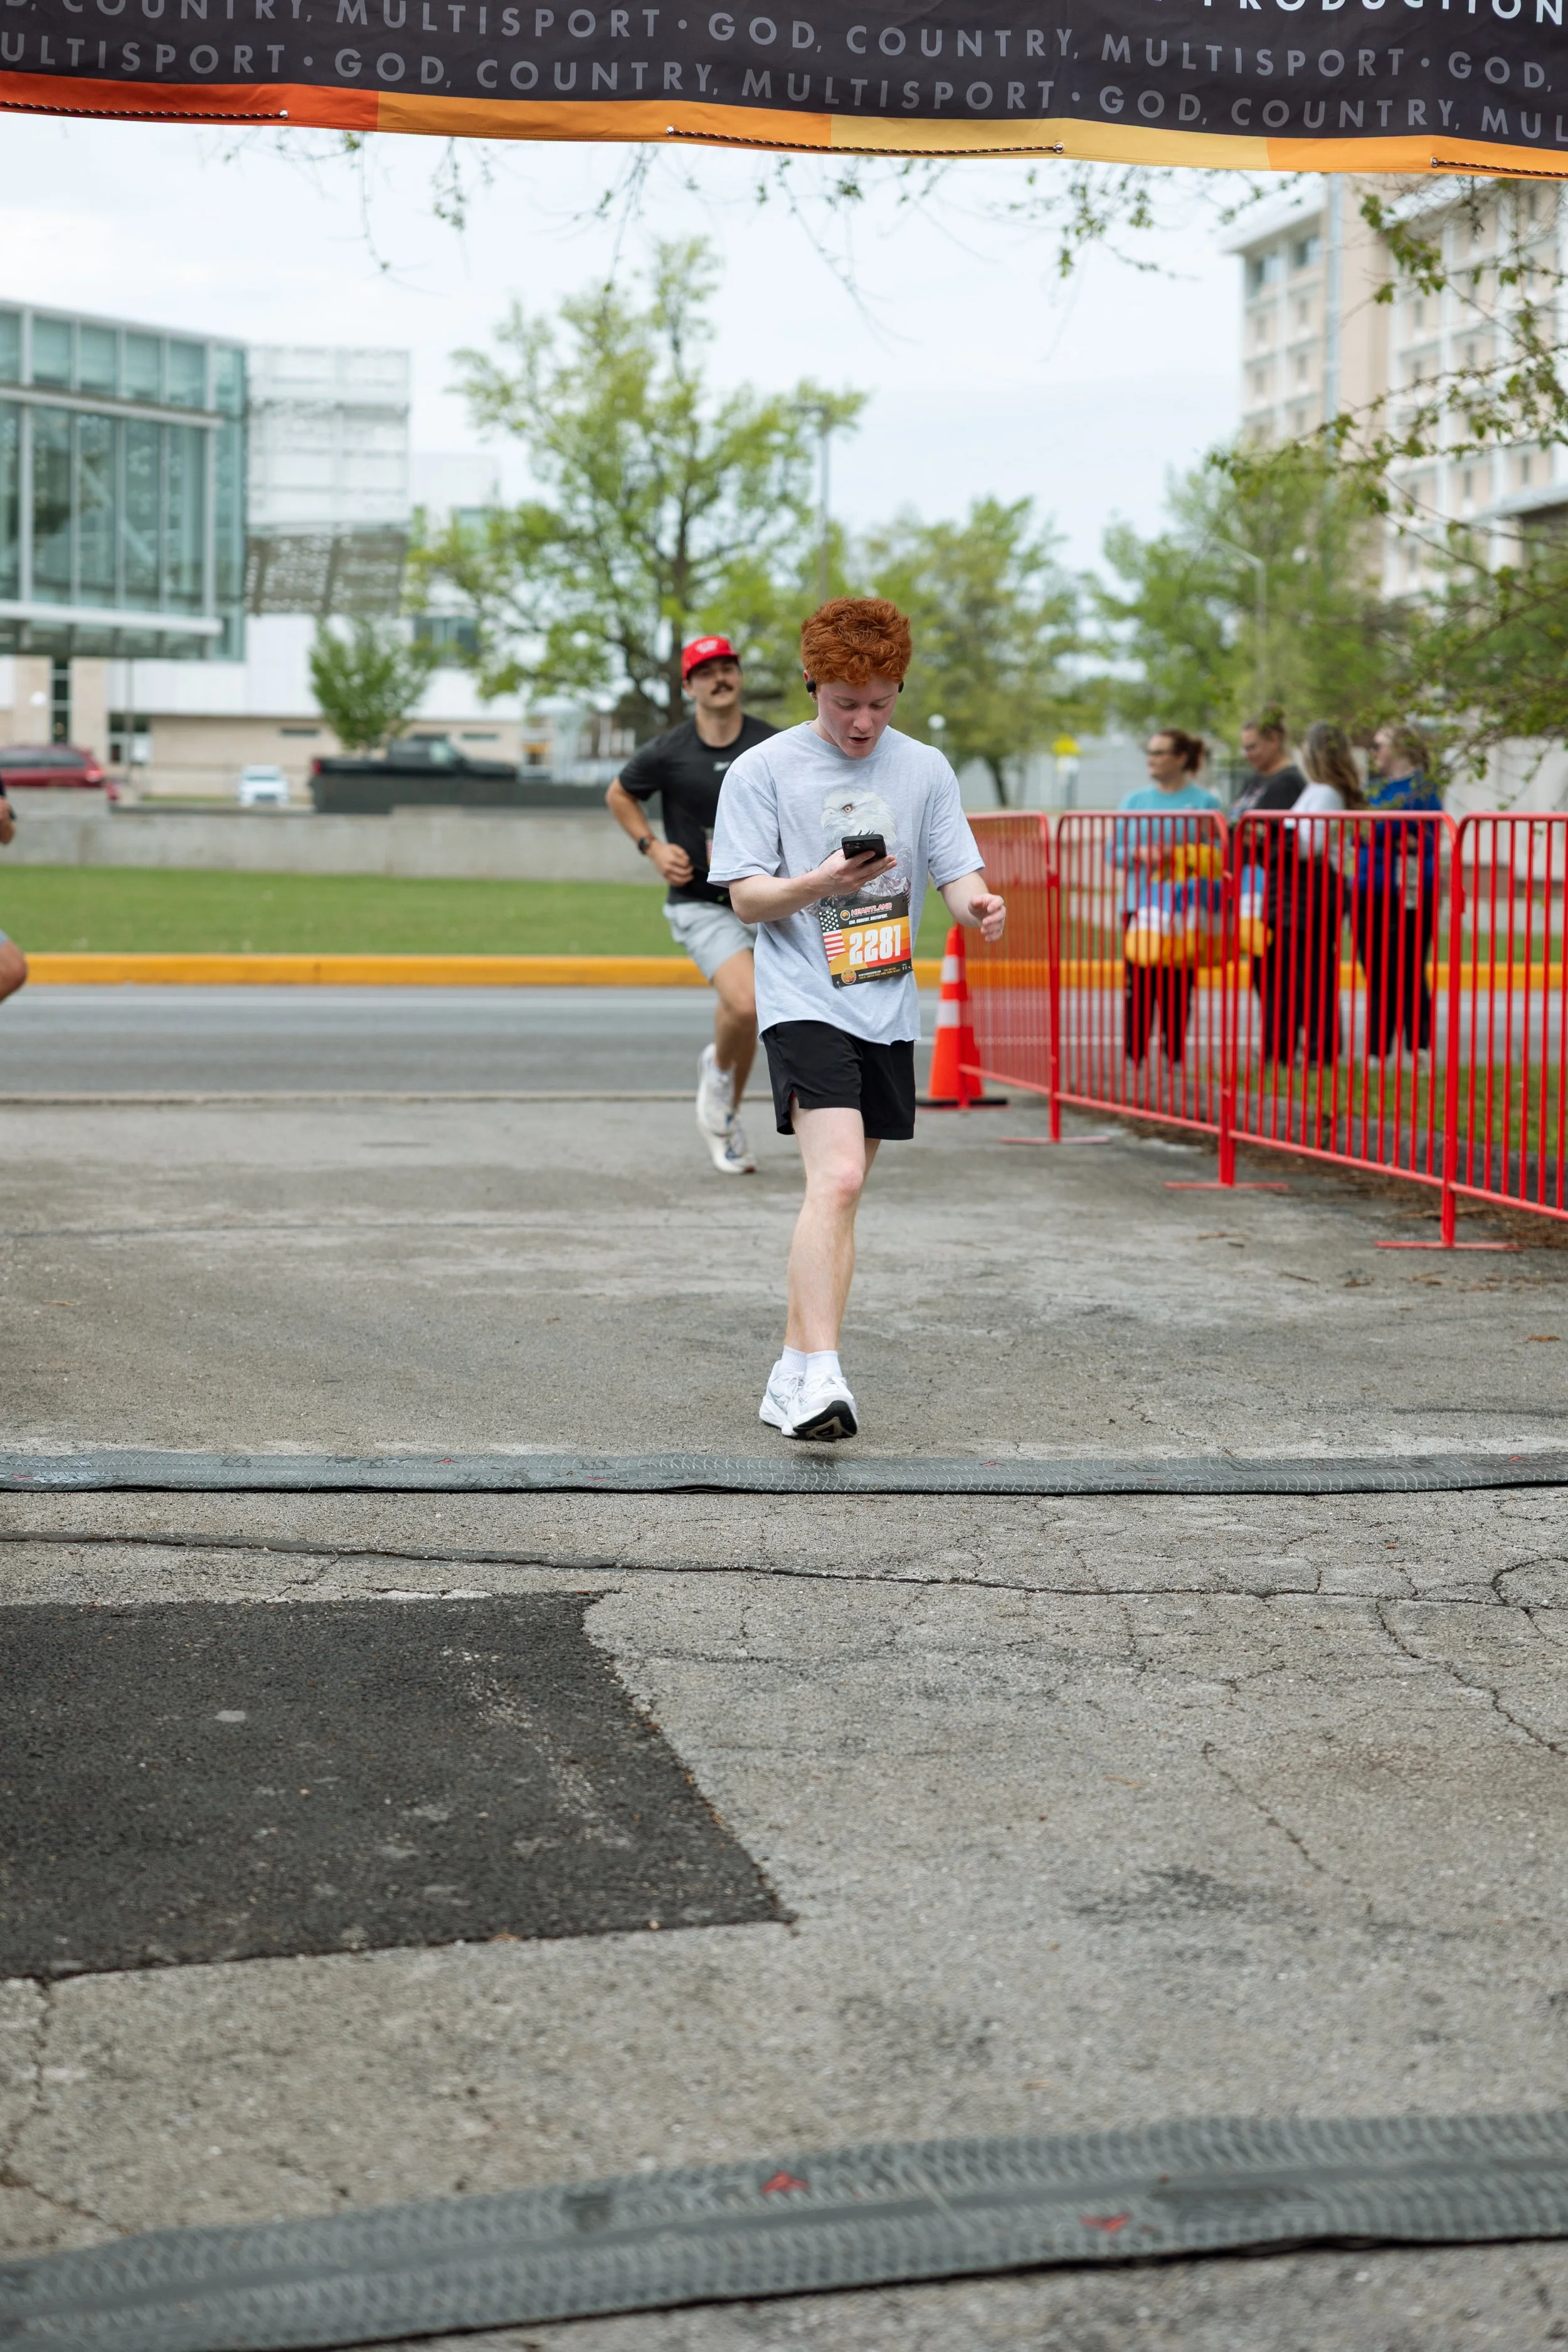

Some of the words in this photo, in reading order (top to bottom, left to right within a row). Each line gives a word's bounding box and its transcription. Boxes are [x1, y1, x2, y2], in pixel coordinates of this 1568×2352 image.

[335, 0, 660, 38] MULTISPORT
[708, 12, 822, 53] GOD,
[846, 25, 1079, 60] COUNTRY,
[1101, 33, 1404, 77] MULTISPORT
[1448, 51, 1552, 92] GOD,
[335, 48, 452, 88] GOD,
[477, 59, 719, 96] COUNTRY,
[741, 69, 1055, 110] MULTISPORT
[1099, 85, 1207, 125] GOD,
[1231, 98, 1460, 130] COUNTRY,
[850, 903, 893, 916] HEARTLAND
[849, 924, 901, 965] 2281
